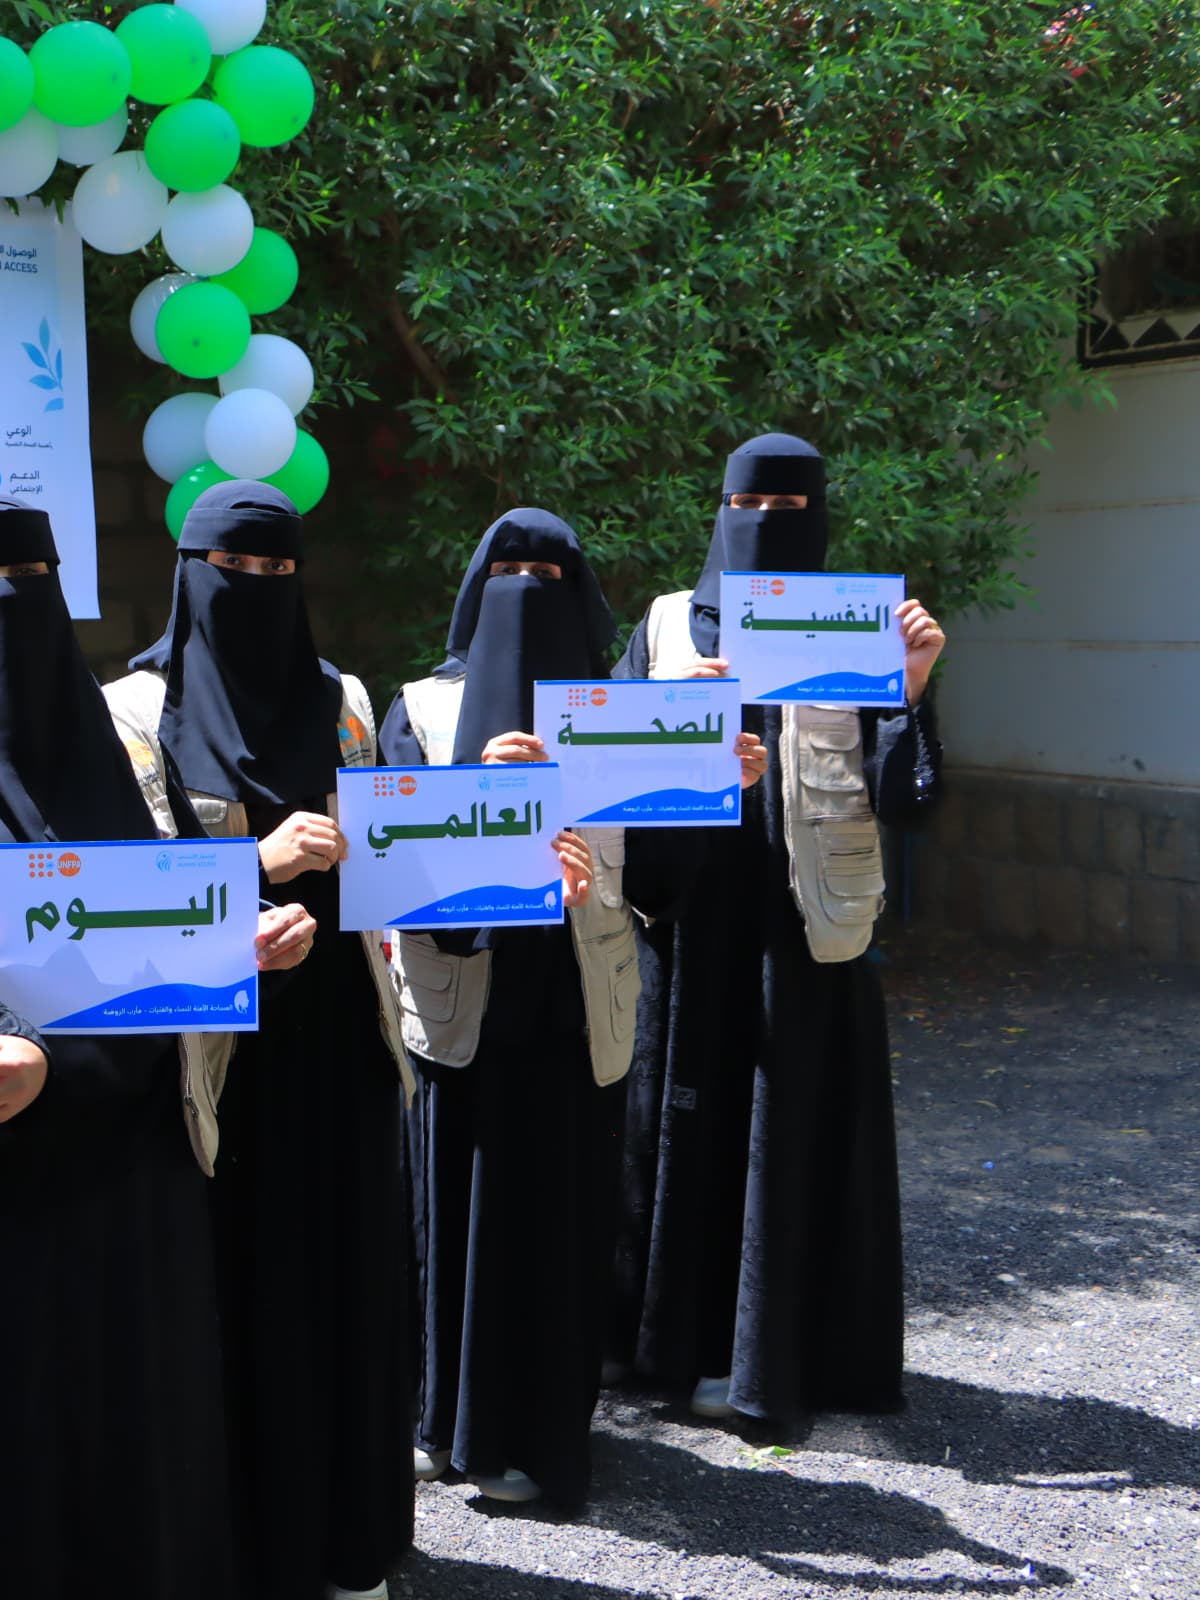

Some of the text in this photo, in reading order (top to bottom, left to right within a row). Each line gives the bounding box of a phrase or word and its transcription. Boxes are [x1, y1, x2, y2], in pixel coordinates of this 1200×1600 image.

[4, 262, 38, 274] ACCESS
[7, 245, 37, 259] الوصول
[6, 425, 32, 439] الوعي
[741, 602, 889, 639] النفسية
[558, 712, 723, 745] للصحة
[367, 800, 542, 858] العالمي
[25, 882, 227, 943] اليوم
